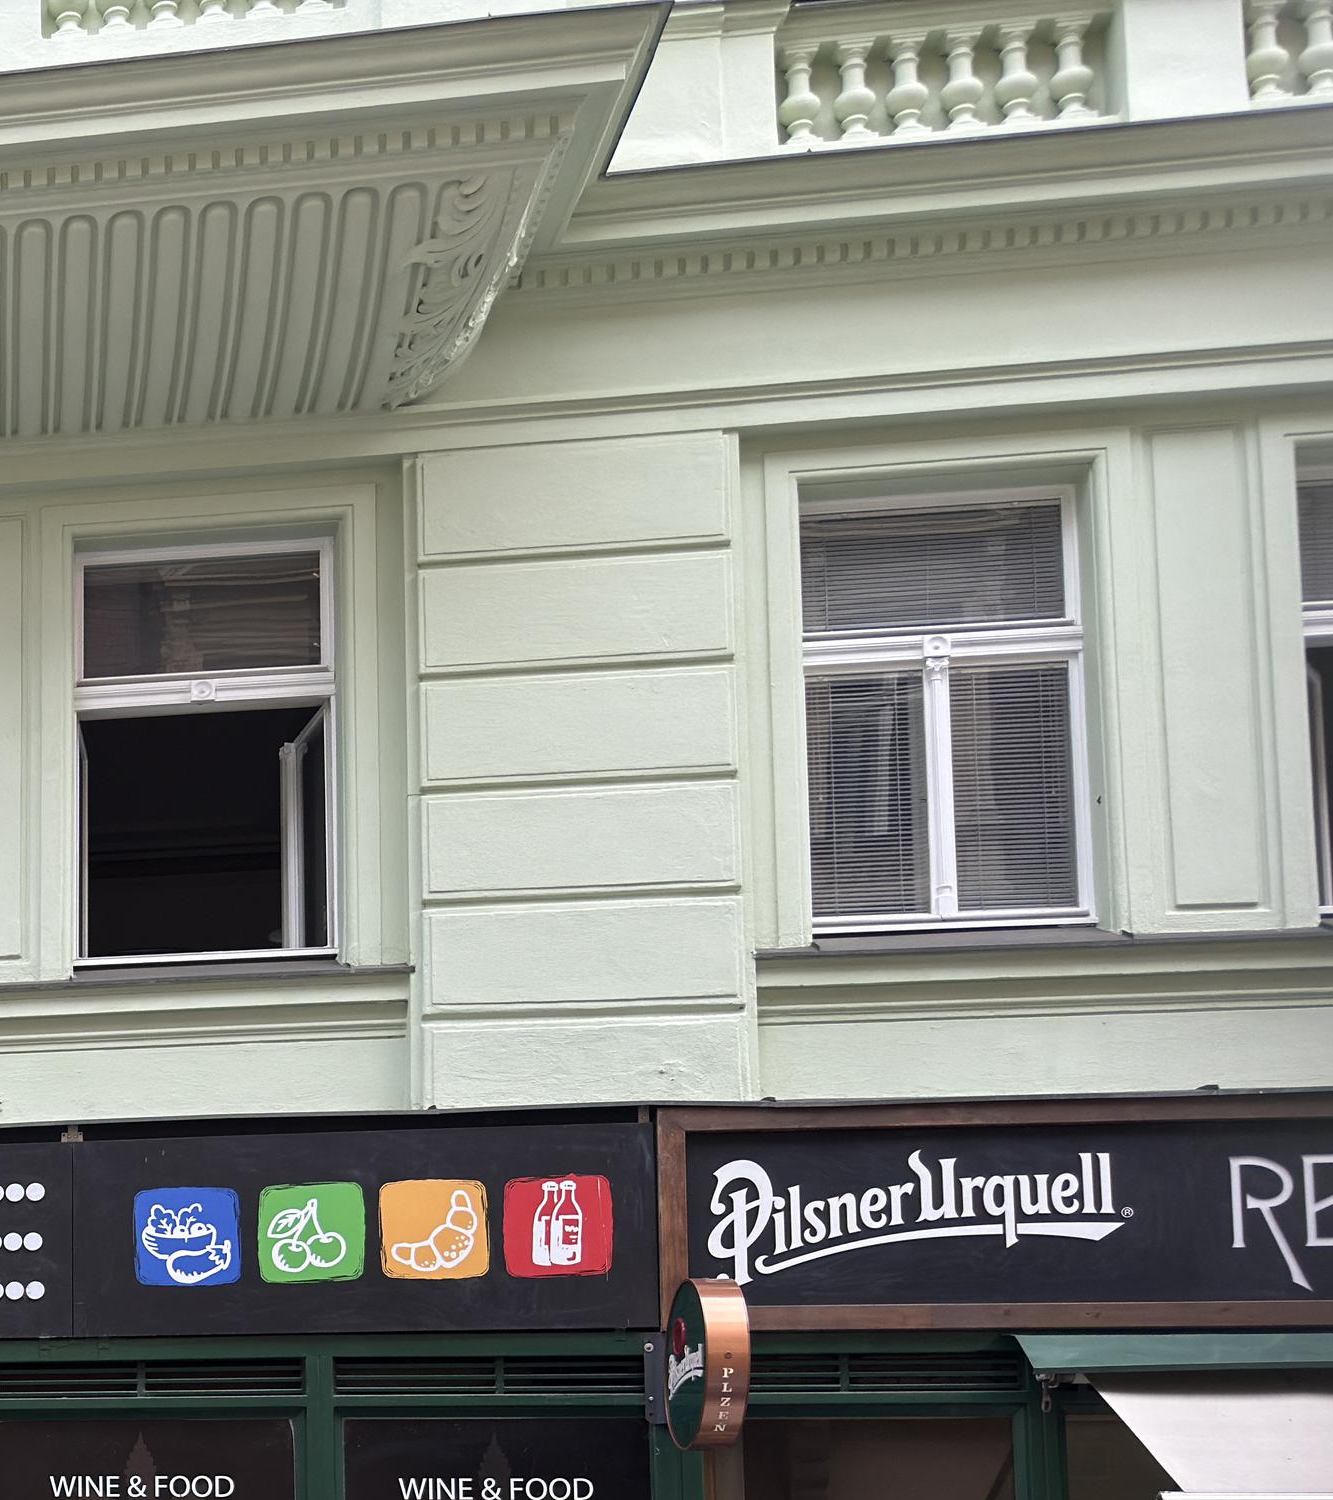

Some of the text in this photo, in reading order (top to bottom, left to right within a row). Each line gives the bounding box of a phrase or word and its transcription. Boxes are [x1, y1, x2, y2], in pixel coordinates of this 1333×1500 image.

[707, 1149, 1115, 1286] Pilsner Urquell
[50, 1475, 234, 1498] WINE & FOOD
[399, 1478, 594, 1500] WINE & FOOD
